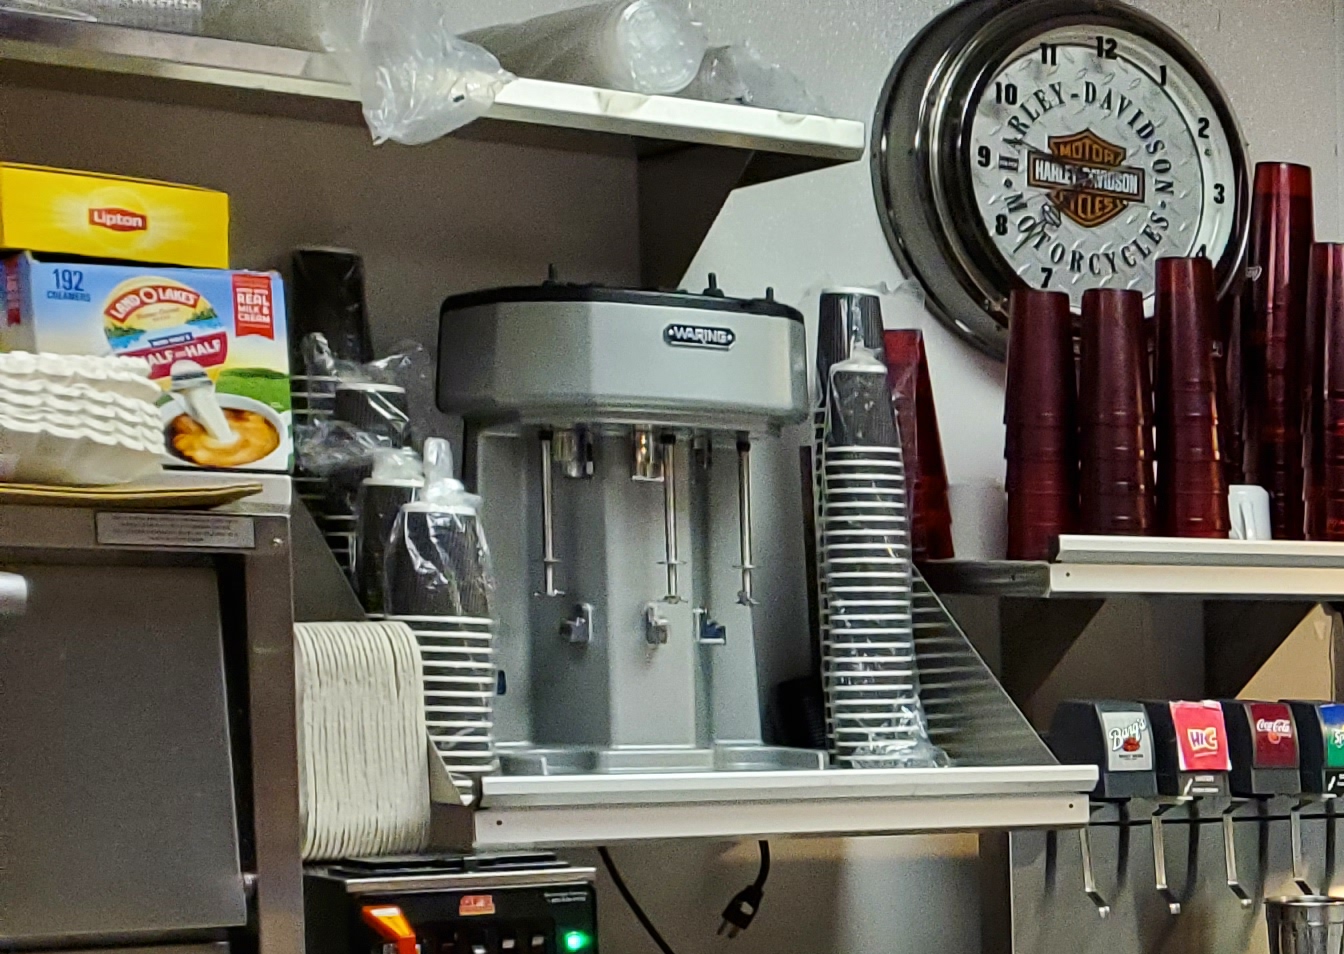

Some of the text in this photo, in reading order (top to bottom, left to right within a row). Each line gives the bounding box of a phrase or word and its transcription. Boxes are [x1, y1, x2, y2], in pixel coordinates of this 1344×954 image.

[1040, 43, 1057, 66] 11
[1095, 36, 1118, 60] 12
[1158, 65, 1168, 86] 1
[995, 82, 1018, 106] 10
[998, 81, 1175, 196] HARLEY-DAVIDSON
[1198, 117, 1210, 139] 2
[978, 145, 991, 168] 9
[1059, 140, 1114, 165] MOTOR
[1213, 183, 1226, 205] 3
[93, 210, 143, 227] Lipton
[995, 214, 1008, 237] 8
[53, 268, 84, 292] 192
[1040, 267, 1053, 289] 7
[109, 294, 141, 320] LAND
[139, 286, 158, 305] O
[237, 293, 270, 306] REAL
[673, 326, 728, 343] WARING
[146, 349, 174, 365] ALF
[183, 338, 221, 358] HALF
[1109, 716, 1147, 751] Barq's
